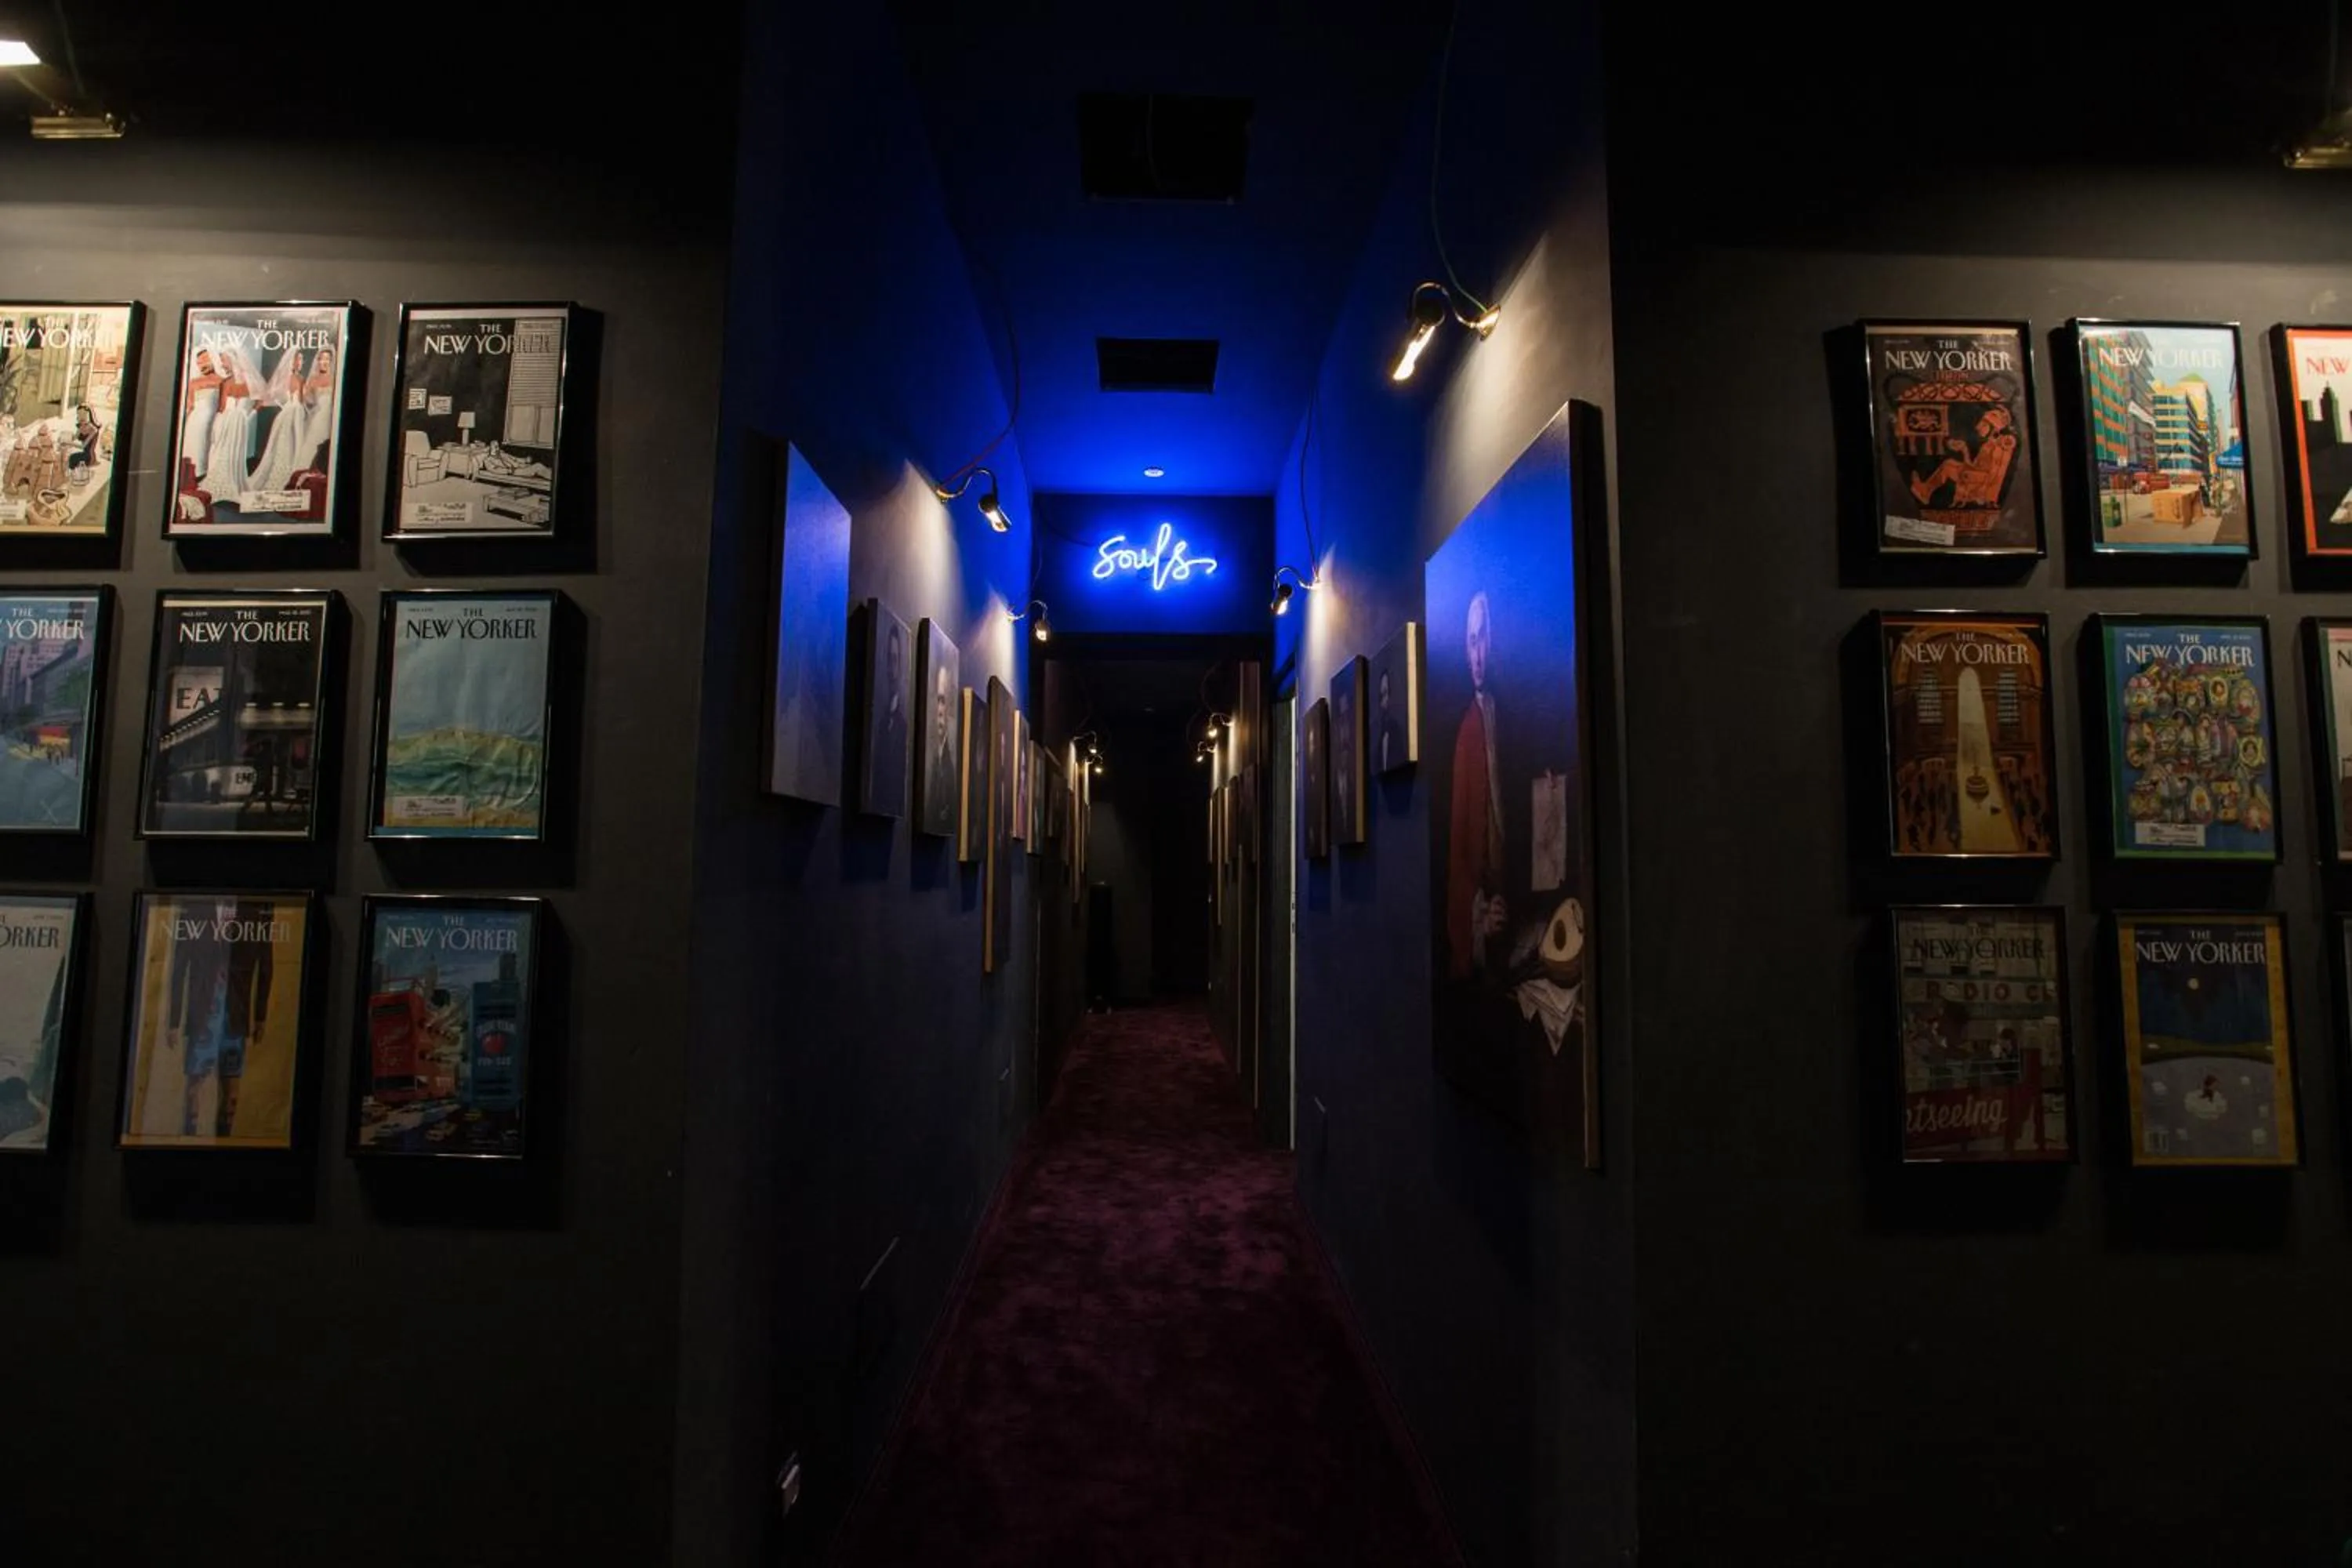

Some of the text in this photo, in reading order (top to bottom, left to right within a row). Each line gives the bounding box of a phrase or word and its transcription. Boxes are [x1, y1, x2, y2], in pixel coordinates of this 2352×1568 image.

[257, 319, 277, 328] THE
[479, 323, 502, 333] THE
[1, 328, 35, 347] EW
[199, 329, 329, 350] NEW YORKER
[424, 335, 471, 354] NEW
[1936, 339, 1958, 349] THE
[1885, 350, 2013, 371] NEW YORKER
[2096, 347, 2145, 368] NEW
[2306, 356, 2350, 375] NEW
[12, 607, 33, 616] THE
[234, 610, 258, 620] THE
[463, 608, 483, 616] THE
[5, 618, 84, 641] YORKER
[180, 620, 311, 643] NEW YORKER
[405, 618, 537, 640] NEW YORKER
[2177, 633, 2201, 644] THE
[1900, 643, 2029, 664] NEW YORKER
[2125, 644, 2256, 667] NEW YORKER
[159, 919, 291, 942] NEW YORKER
[442, 915, 464, 926] THE
[0, 925, 60, 949] ORKER
[384, 927, 518, 951] NEW YORKER
[2188, 930, 2209, 939] THE
[1912, 938, 2045, 959] NEW YORKER
[2136, 942, 2265, 964] NEW YORKER
[1926, 980, 2010, 1001] RDIO
